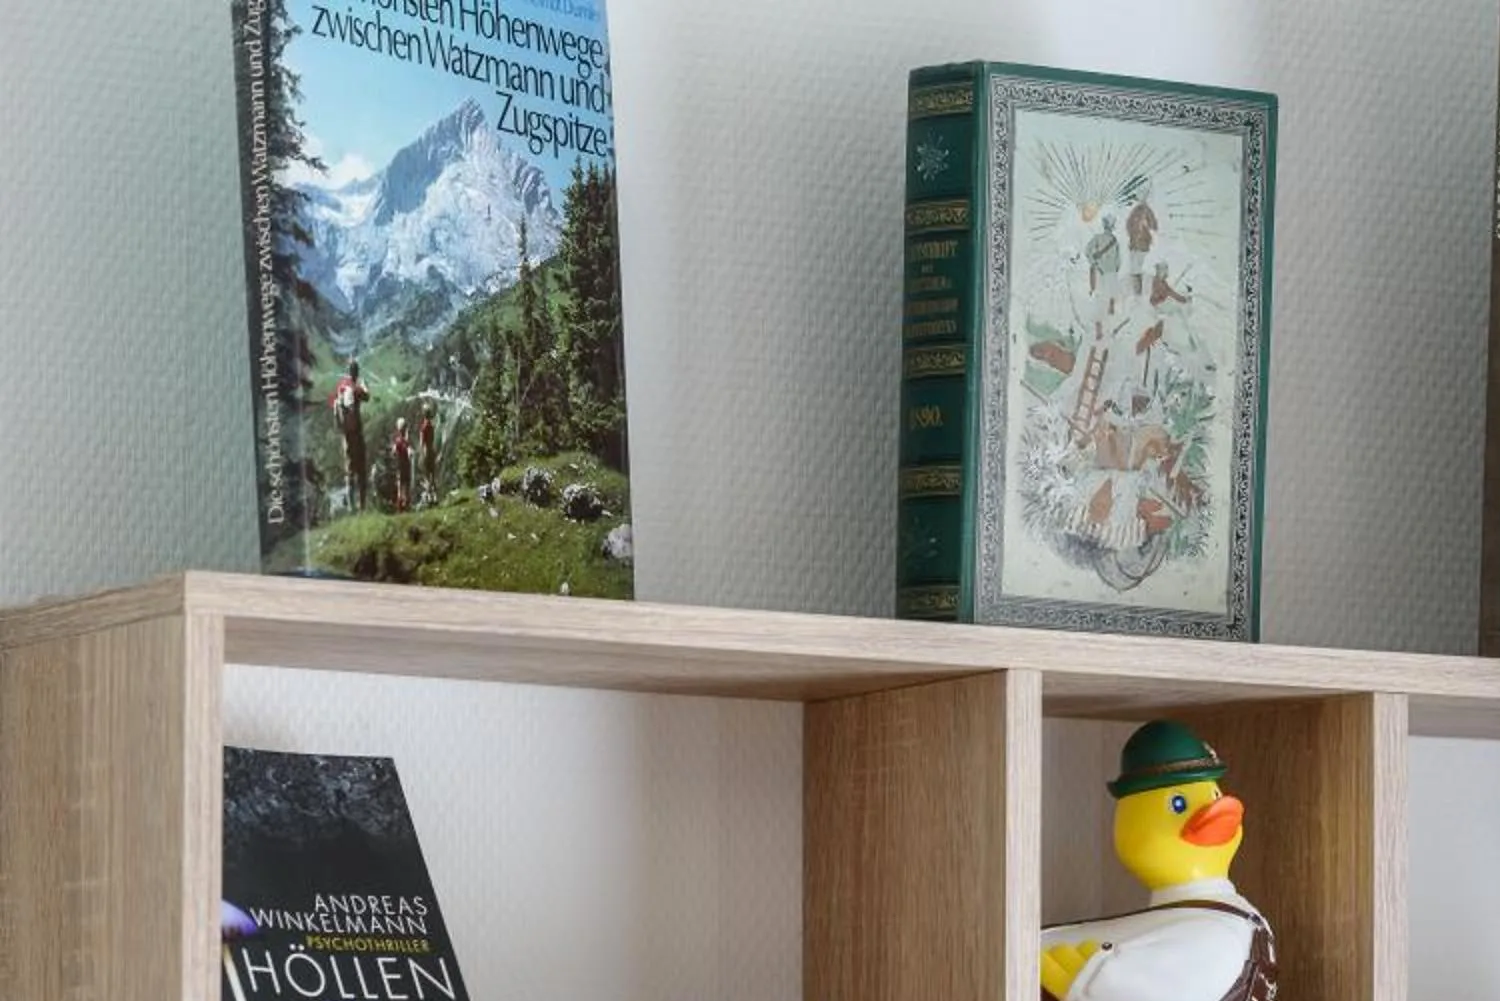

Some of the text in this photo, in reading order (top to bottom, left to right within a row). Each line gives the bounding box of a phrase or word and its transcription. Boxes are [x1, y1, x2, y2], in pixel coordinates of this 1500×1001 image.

[243, 39, 265, 78] und
[312, 5, 606, 114] zwischen Watzmann und
[250, 80, 268, 185] Watzmann
[496, 90, 609, 159] Zugspitze
[253, 186, 273, 272] zwischen
[250, 907, 428, 936] WINKELMANN
[314, 893, 428, 917] ANDREAS
[241, 943, 456, 1001] HÖLLEN
[305, 934, 431, 953] PSYCHOTHRILLER
